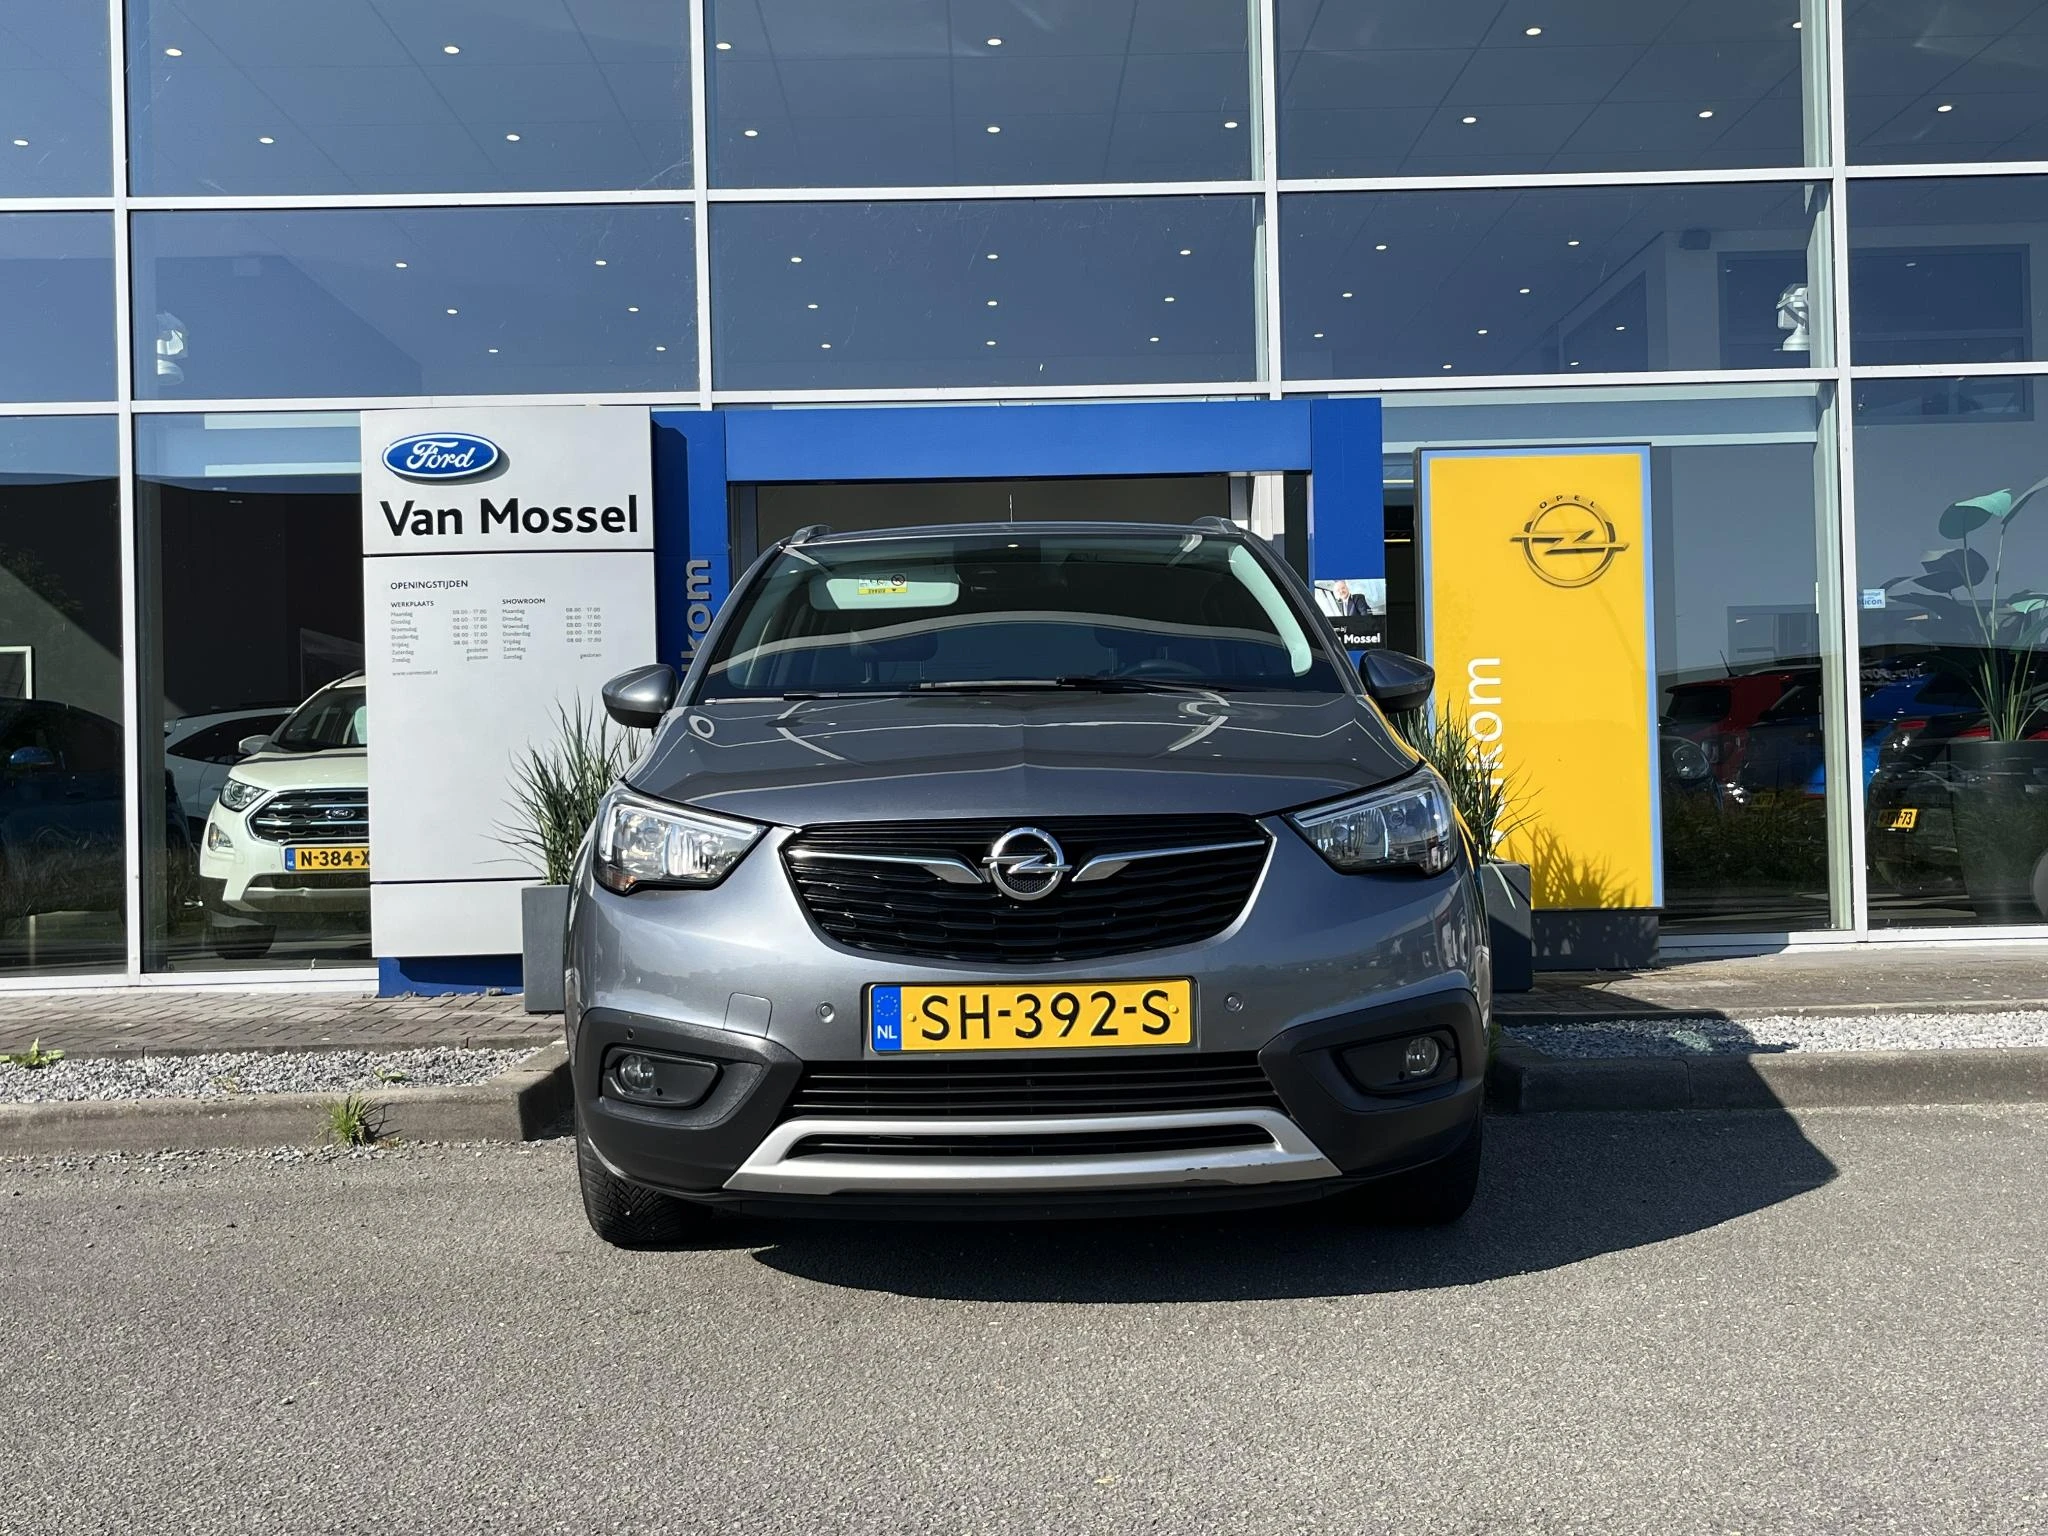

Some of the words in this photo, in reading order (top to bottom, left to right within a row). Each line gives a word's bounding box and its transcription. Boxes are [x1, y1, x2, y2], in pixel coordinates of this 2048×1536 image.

[407, 440, 475, 469] Ford
[1539, 494, 1597, 509] OPEL
[379, 499, 463, 537] Van
[480, 494, 638, 535] Mossel
[390, 580, 469, 590] OPENINGSTIJDEN
[390, 600, 435, 608] WERKPLAATS
[680, 559, 712, 672] kom
[1343, 632, 1381, 644] Mossel
[300, 850, 370, 866] N-384-X
[921, 989, 1171, 1041] SH-392-S
[876, 1024, 898, 1040] NL
